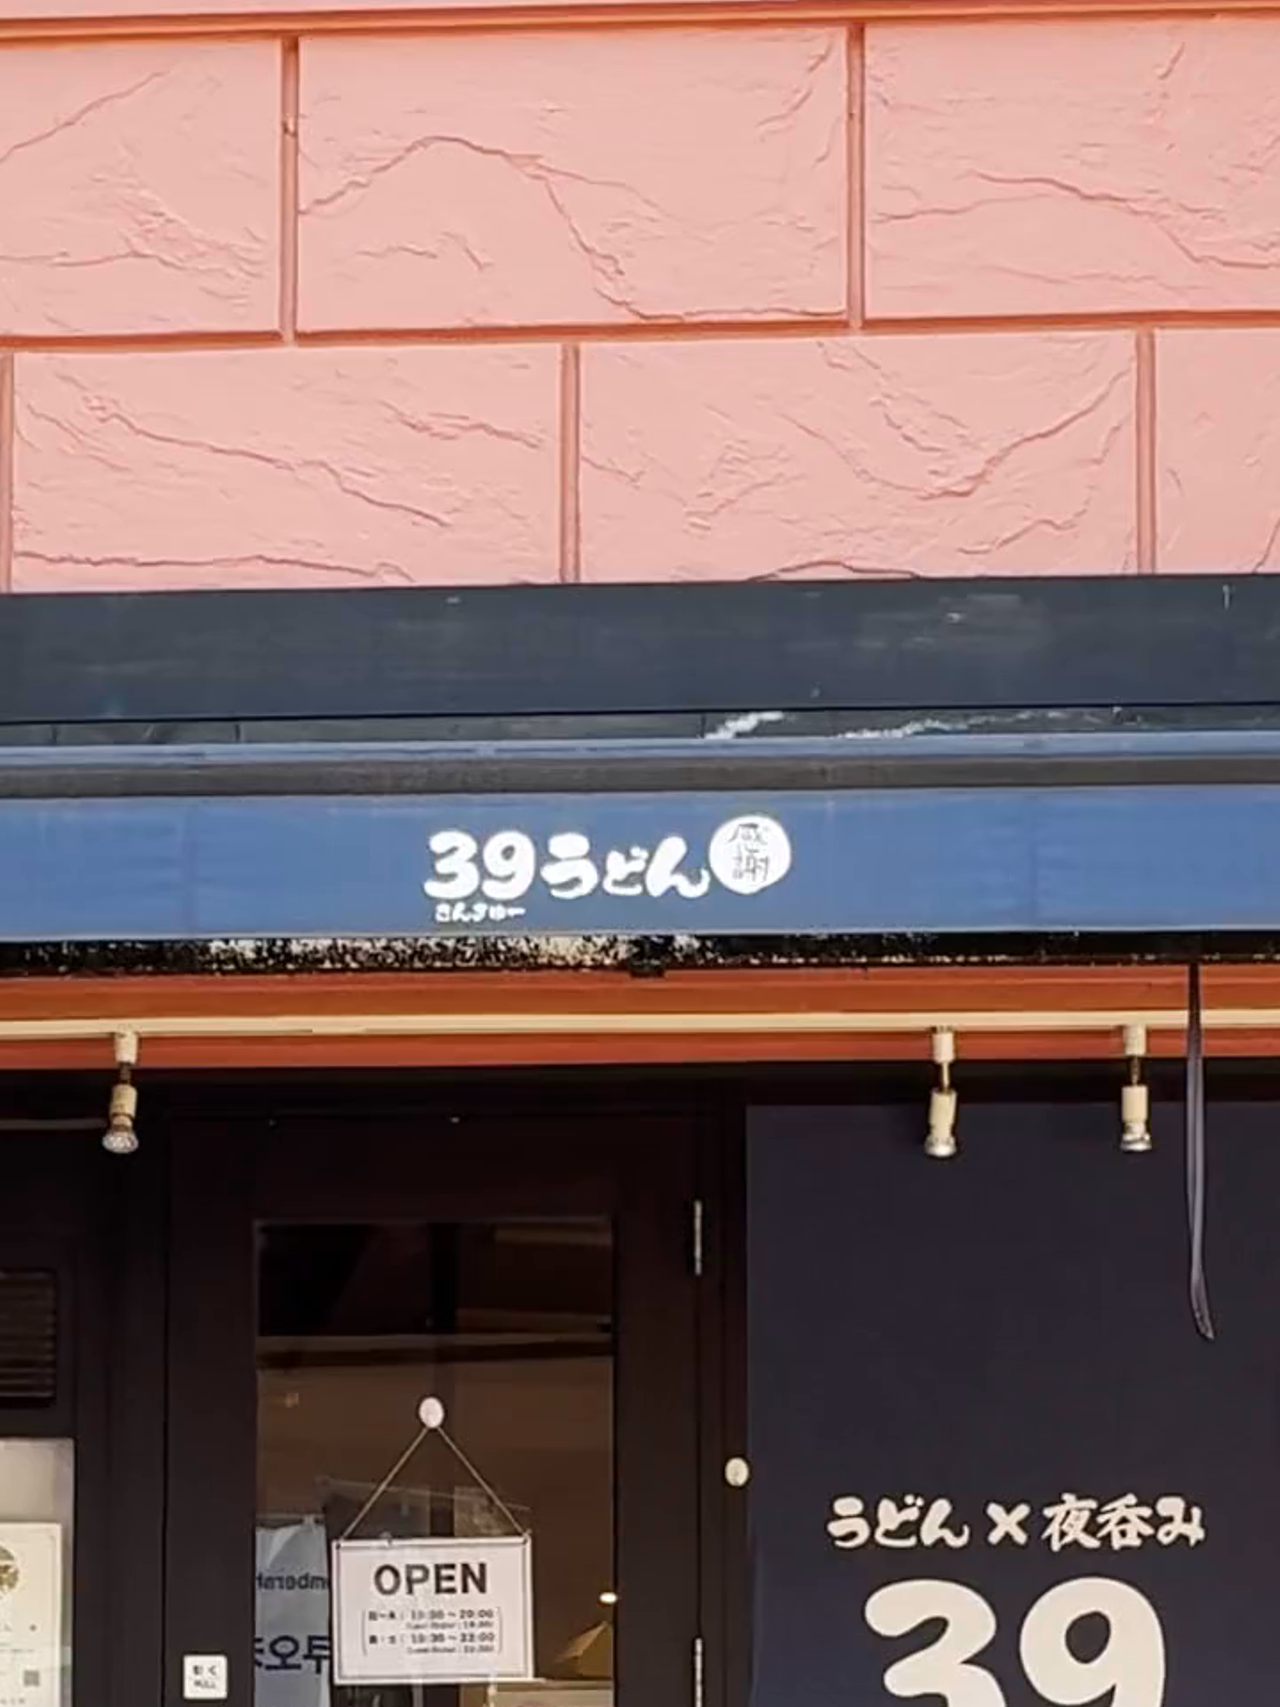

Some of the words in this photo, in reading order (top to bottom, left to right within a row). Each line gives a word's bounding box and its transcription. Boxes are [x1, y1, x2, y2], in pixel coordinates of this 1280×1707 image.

[423, 829, 711, 901] 39うどん
[374, 1563, 488, 1595] OPEN
